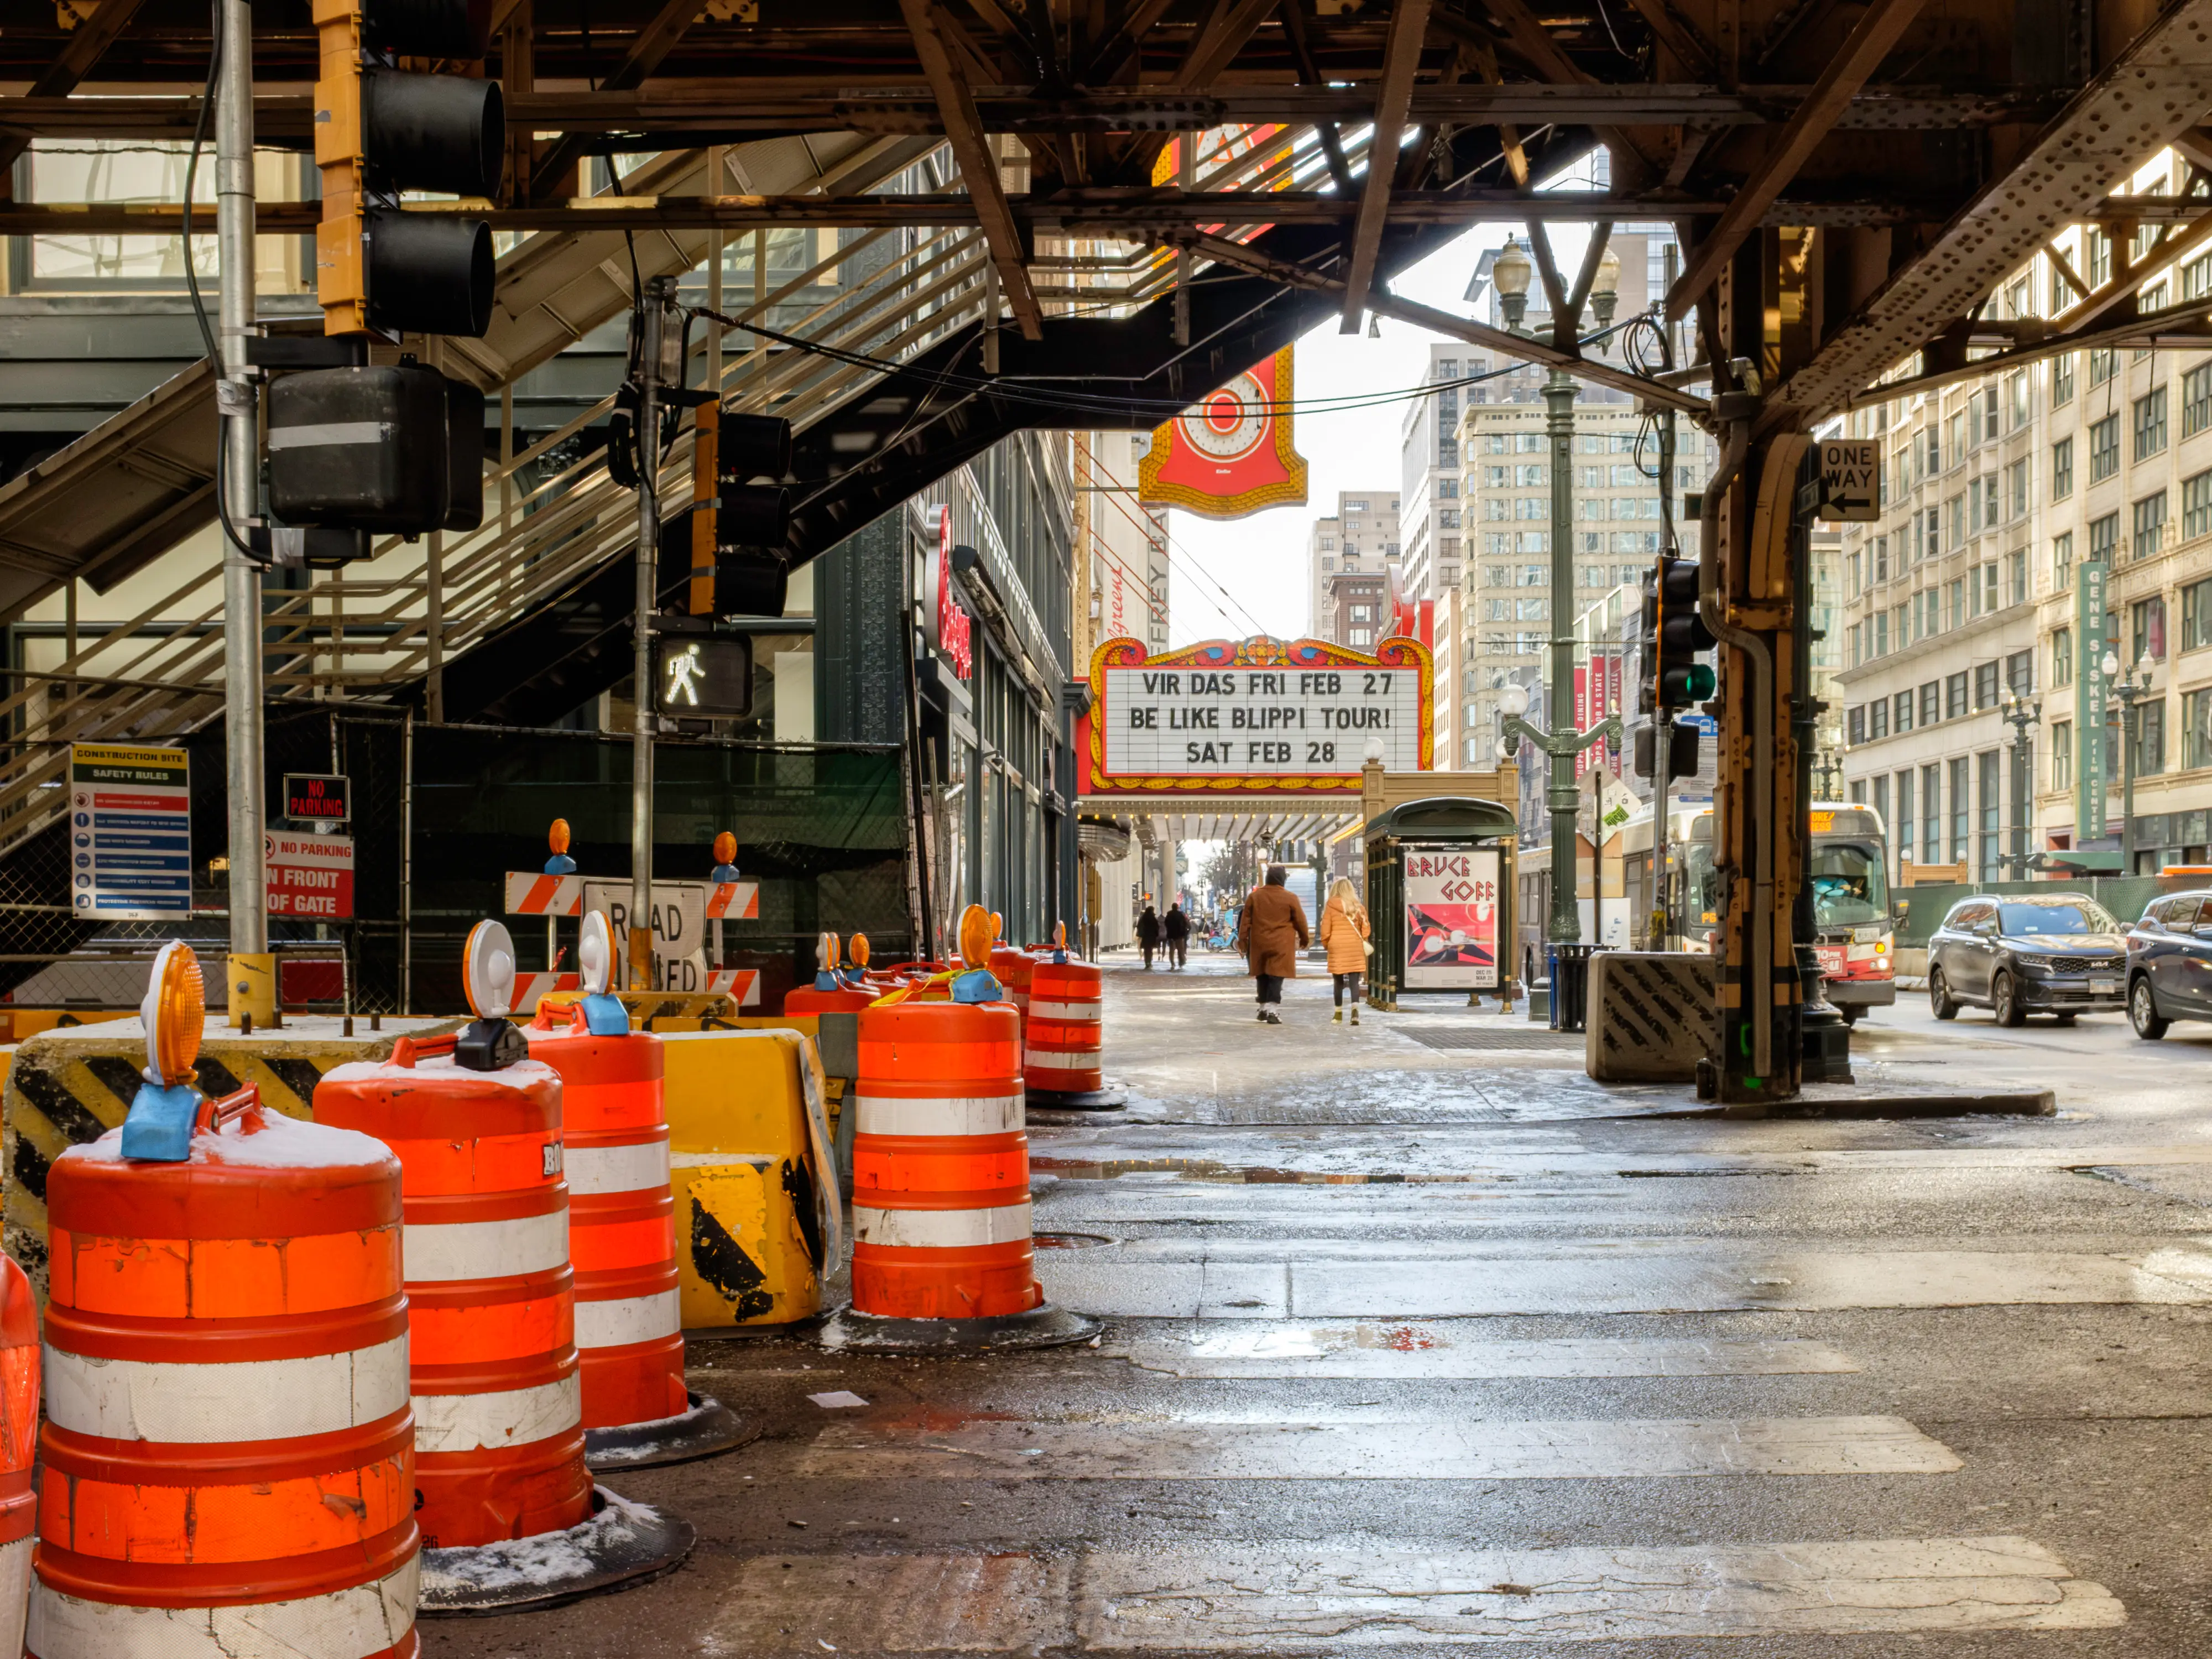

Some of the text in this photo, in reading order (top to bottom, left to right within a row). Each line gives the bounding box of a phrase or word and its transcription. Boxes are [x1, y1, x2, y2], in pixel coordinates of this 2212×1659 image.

[1827, 446, 1872, 465] ONE
[1826, 469, 1872, 488] WAY
[2088, 571, 2100, 728] GENE SISKEL
[1143, 673, 1392, 695] VIR DAS FRI FEB 27
[1130, 707, 1390, 729] BE LIKE BLIPPI TOUR!
[76, 749, 182, 763] CONSTRUCTION SITE
[1187, 742, 1335, 763] SAT FEB 28
[93, 768, 169, 780] SAFETY RULES
[307, 780, 325, 798] NO
[2090, 739, 2099, 832] FILM CENTER
[290, 797, 343, 817] PARKING
[281, 841, 352, 858] NO PARKING
[1407, 856, 1470, 877] BRUCE
[267, 868, 340, 889] N FRONT
[1441, 880, 1494, 901] GOFF
[267, 893, 336, 914] OF GATE
[611, 902, 682, 942] RAD
